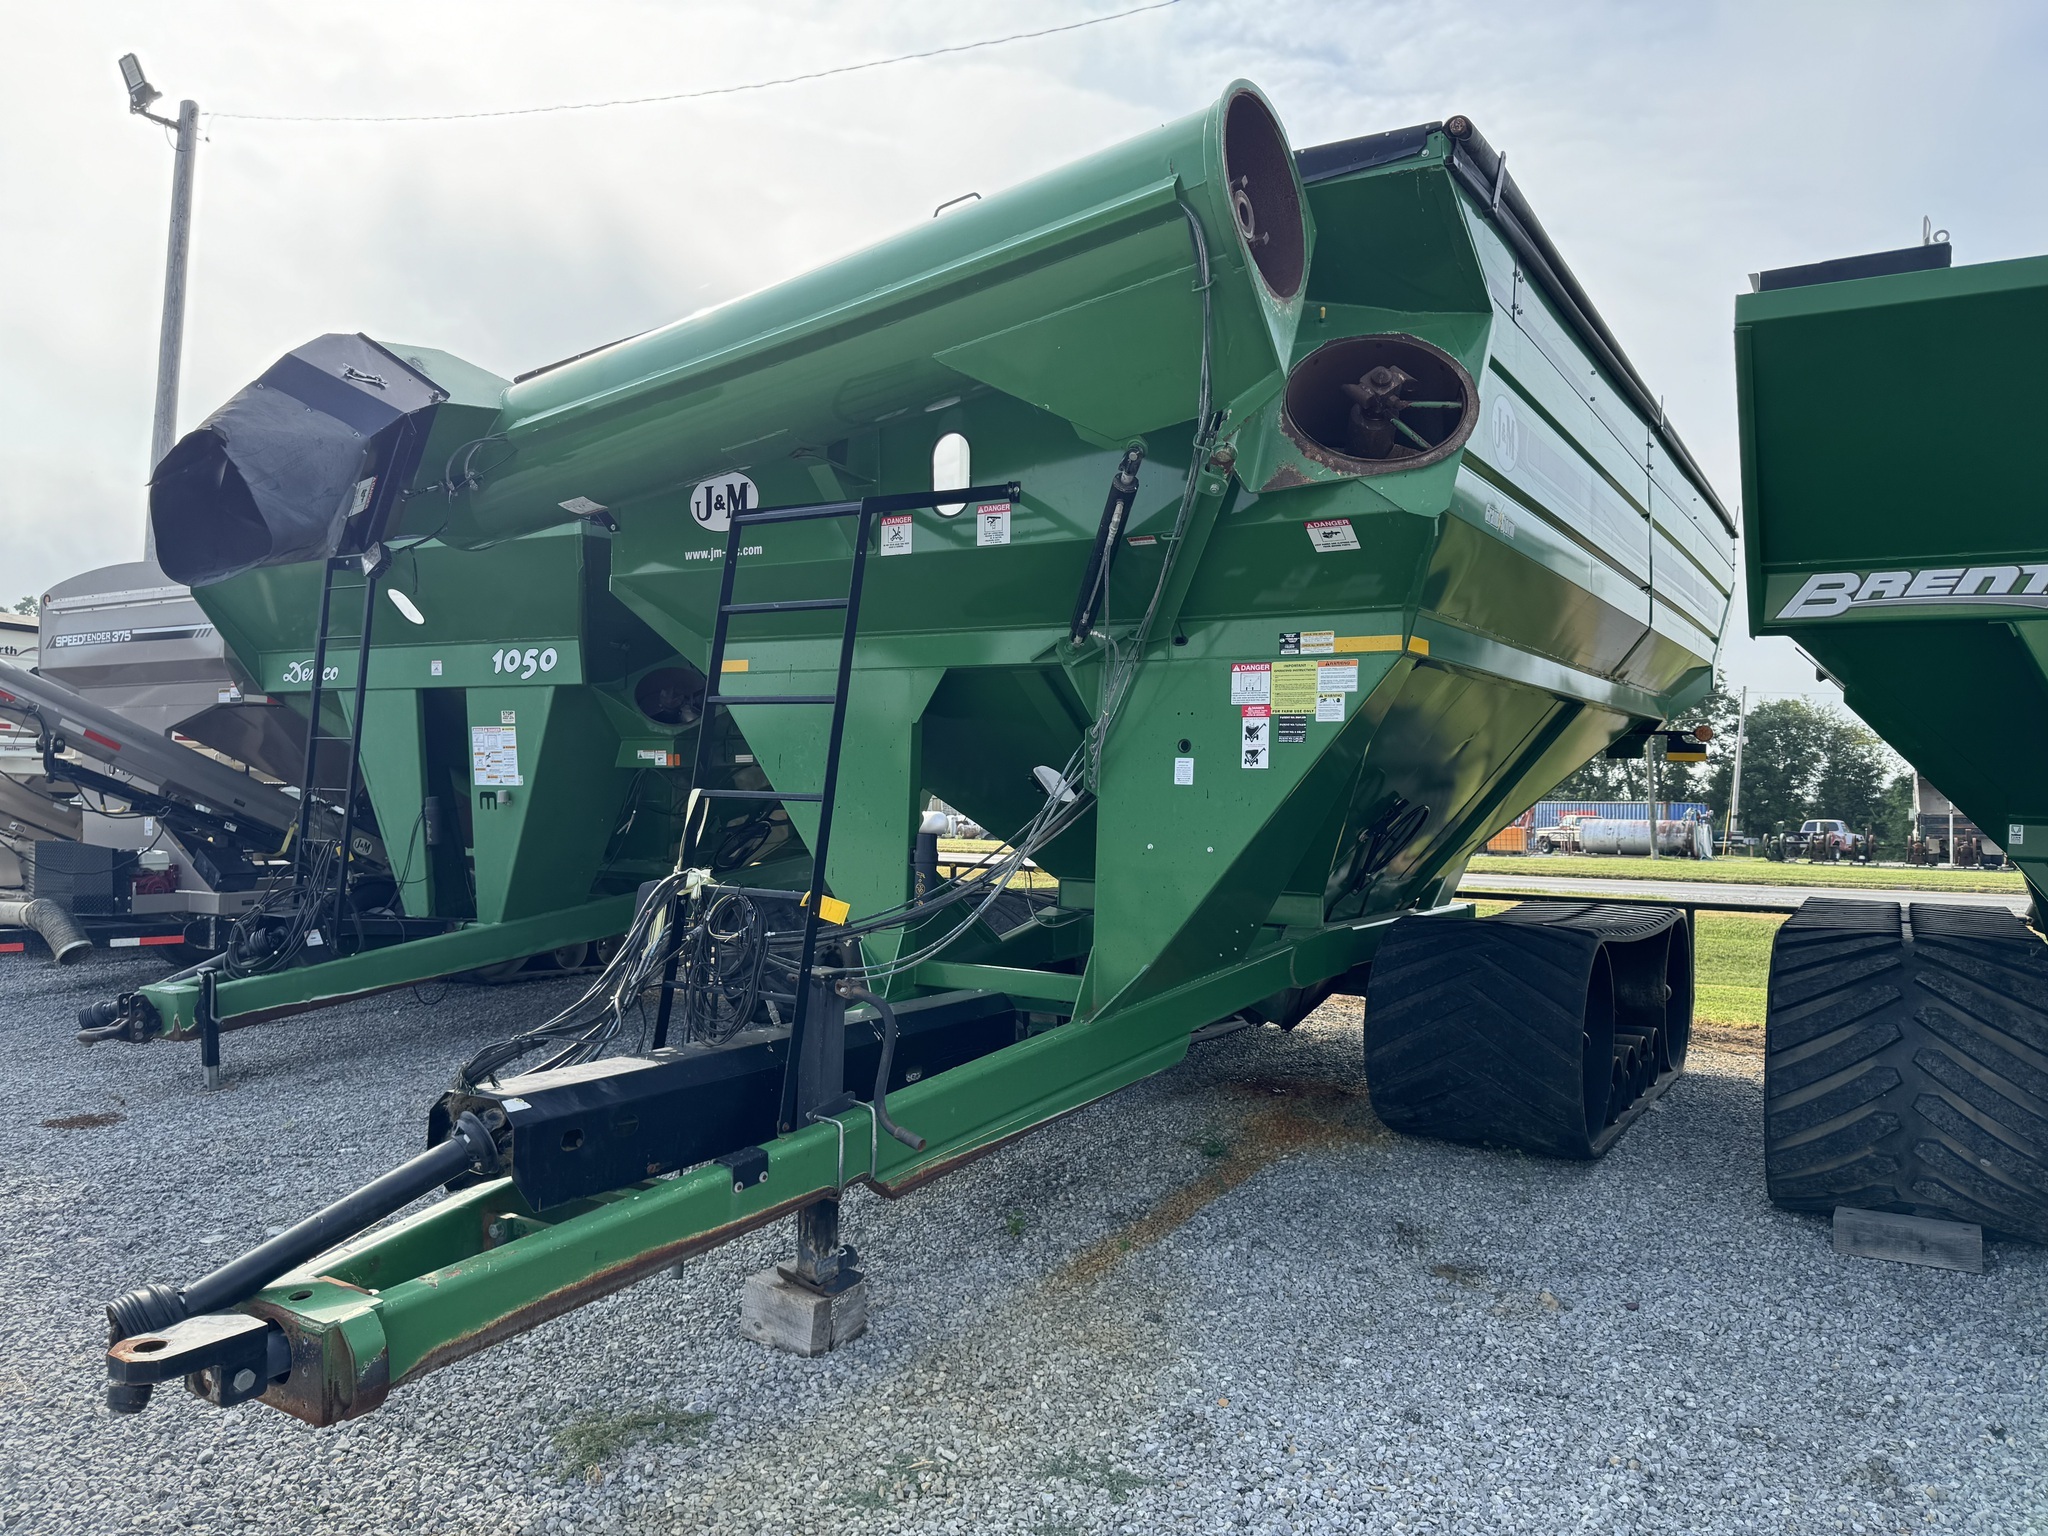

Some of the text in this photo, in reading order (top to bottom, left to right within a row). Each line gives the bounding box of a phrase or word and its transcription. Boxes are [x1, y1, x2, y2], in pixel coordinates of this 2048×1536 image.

[695, 482, 749, 521] J&M
[983, 504, 1011, 513] DANGER
[887, 517, 912, 525] DANGER
[1313, 519, 1350, 528] DANGER
[685, 545, 763, 561] www.jm-.com
[1775, 564, 2048, 619] BRENT
[112, 630, 132, 642] 375
[492, 648, 558, 680] 1050
[355, 839, 371, 854] J&M
